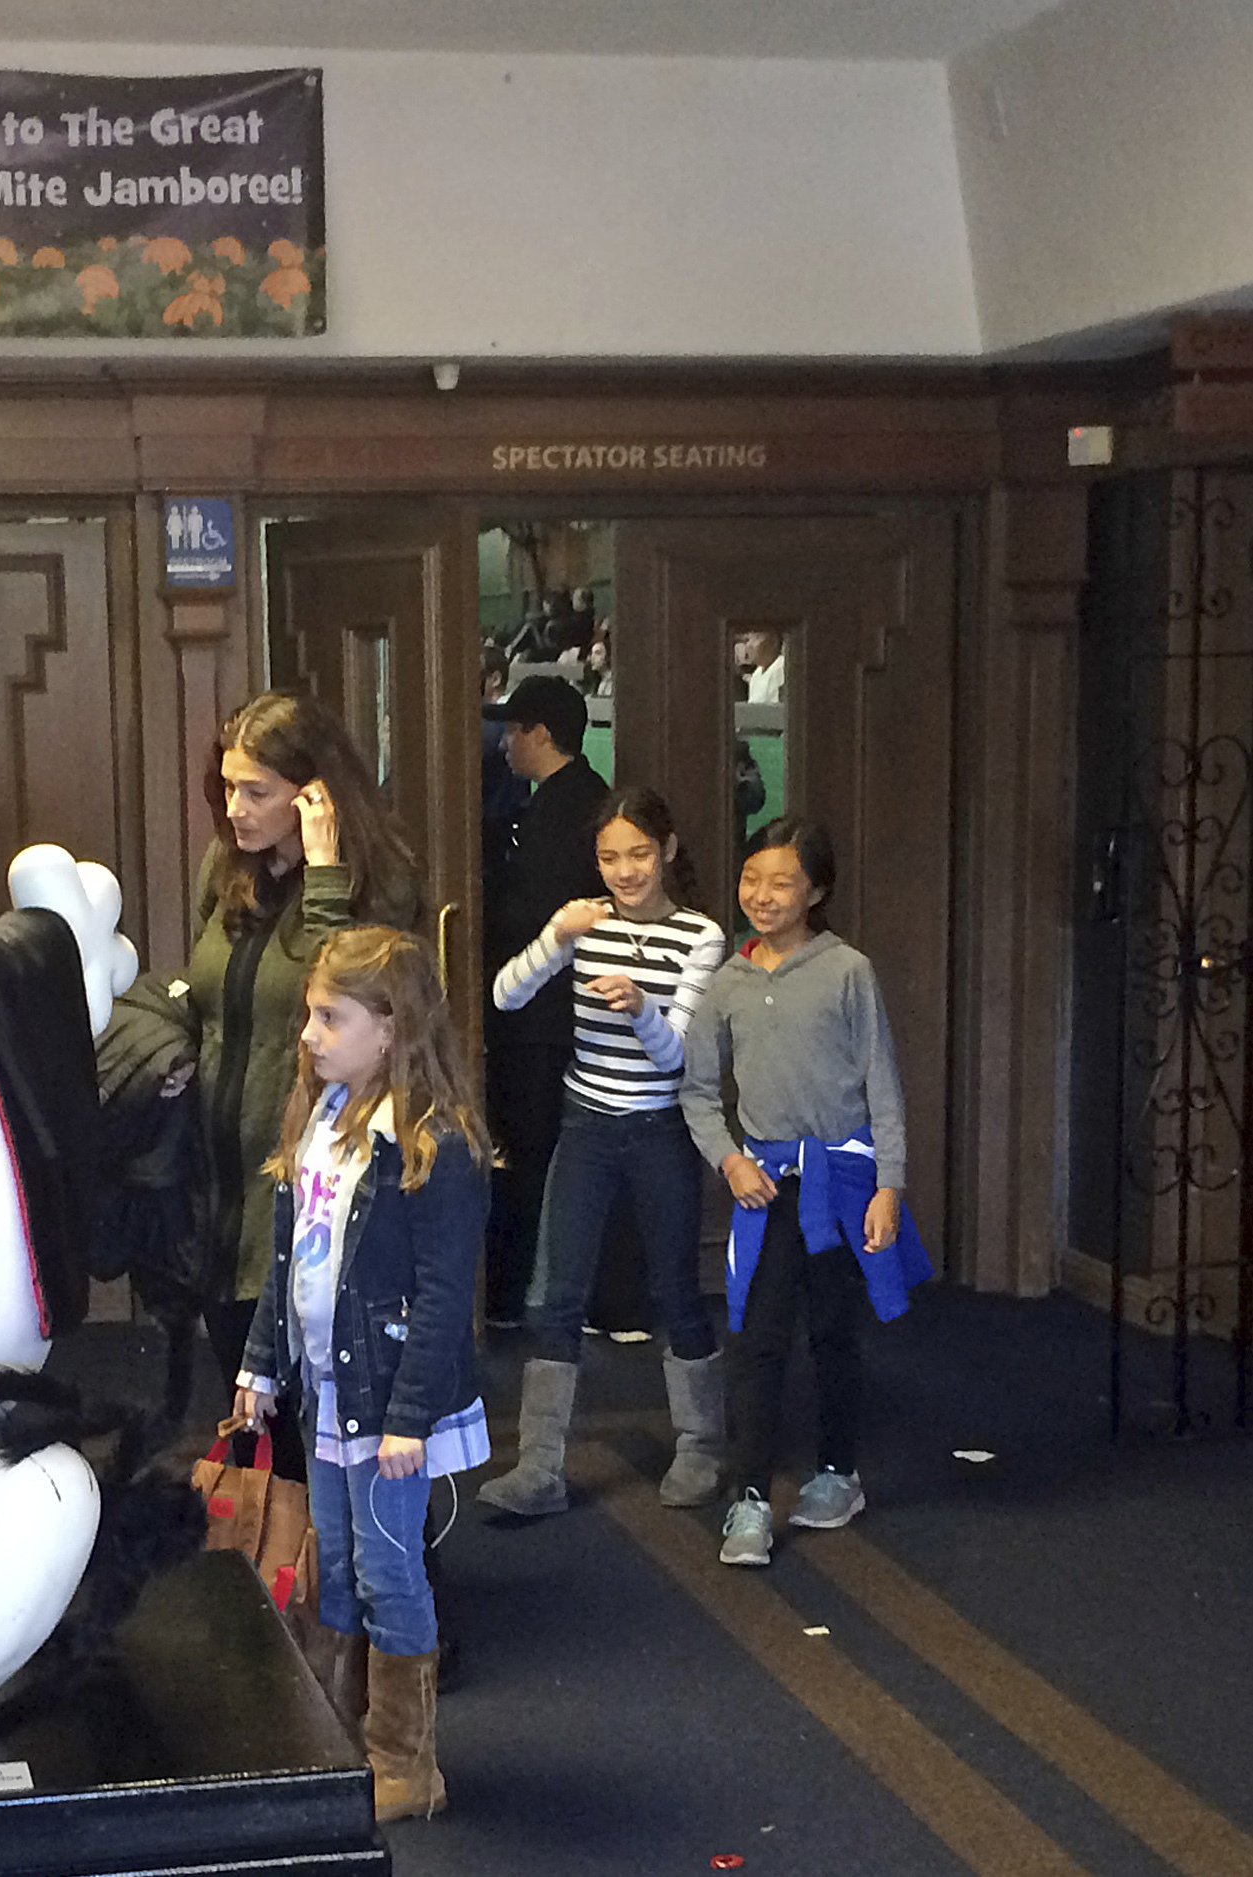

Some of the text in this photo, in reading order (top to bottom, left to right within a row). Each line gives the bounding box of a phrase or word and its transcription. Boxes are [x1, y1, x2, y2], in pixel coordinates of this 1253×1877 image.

[2, 111, 45, 146] to
[60, 105, 135, 147] The
[150, 106, 264, 146] Great
[83, 165, 304, 207] Jamboree!
[492, 443, 768, 471] SPECTATOR SEATING
